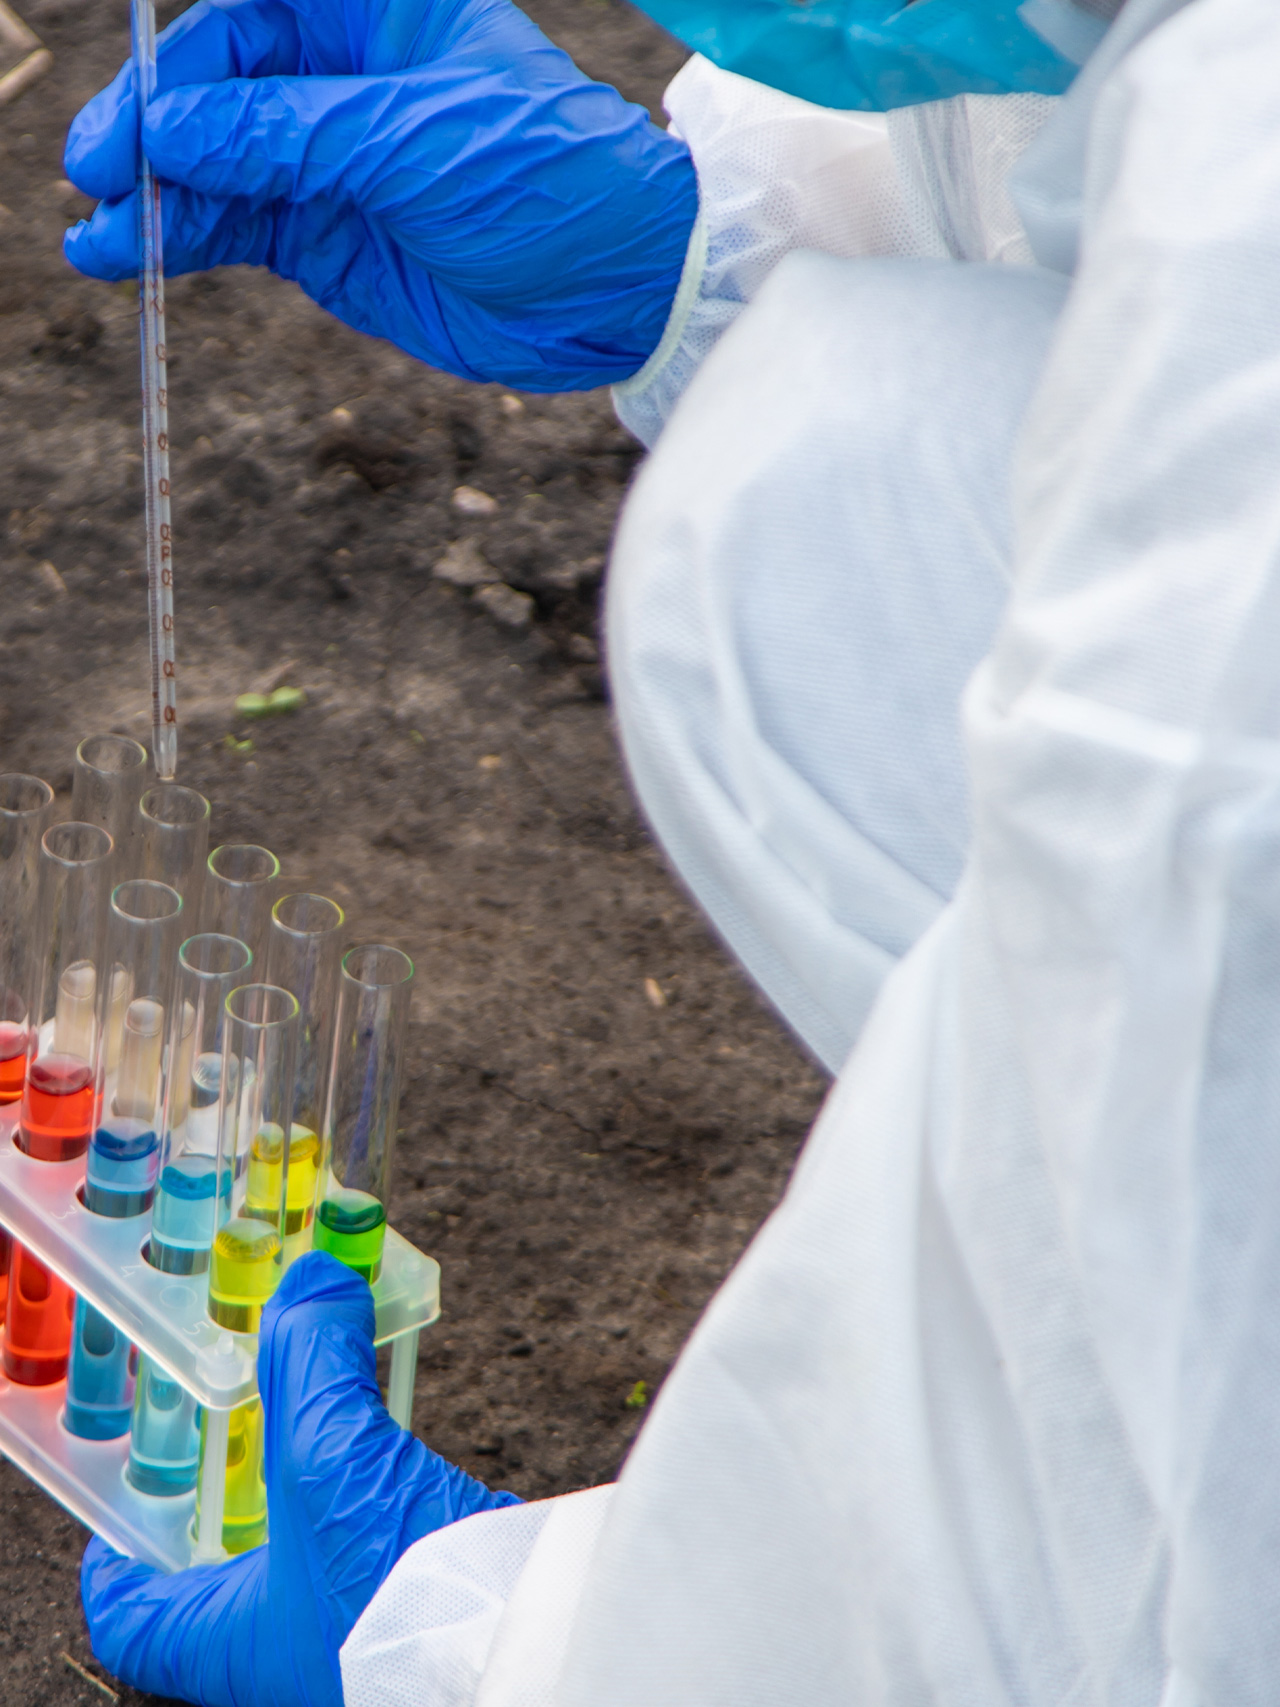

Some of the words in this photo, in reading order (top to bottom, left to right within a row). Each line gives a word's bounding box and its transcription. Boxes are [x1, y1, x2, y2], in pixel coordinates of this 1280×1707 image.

[50, 1205, 77, 1219] 3
[121, 1265, 142, 1278] 4
[182, 1321, 210, 1335] 5
